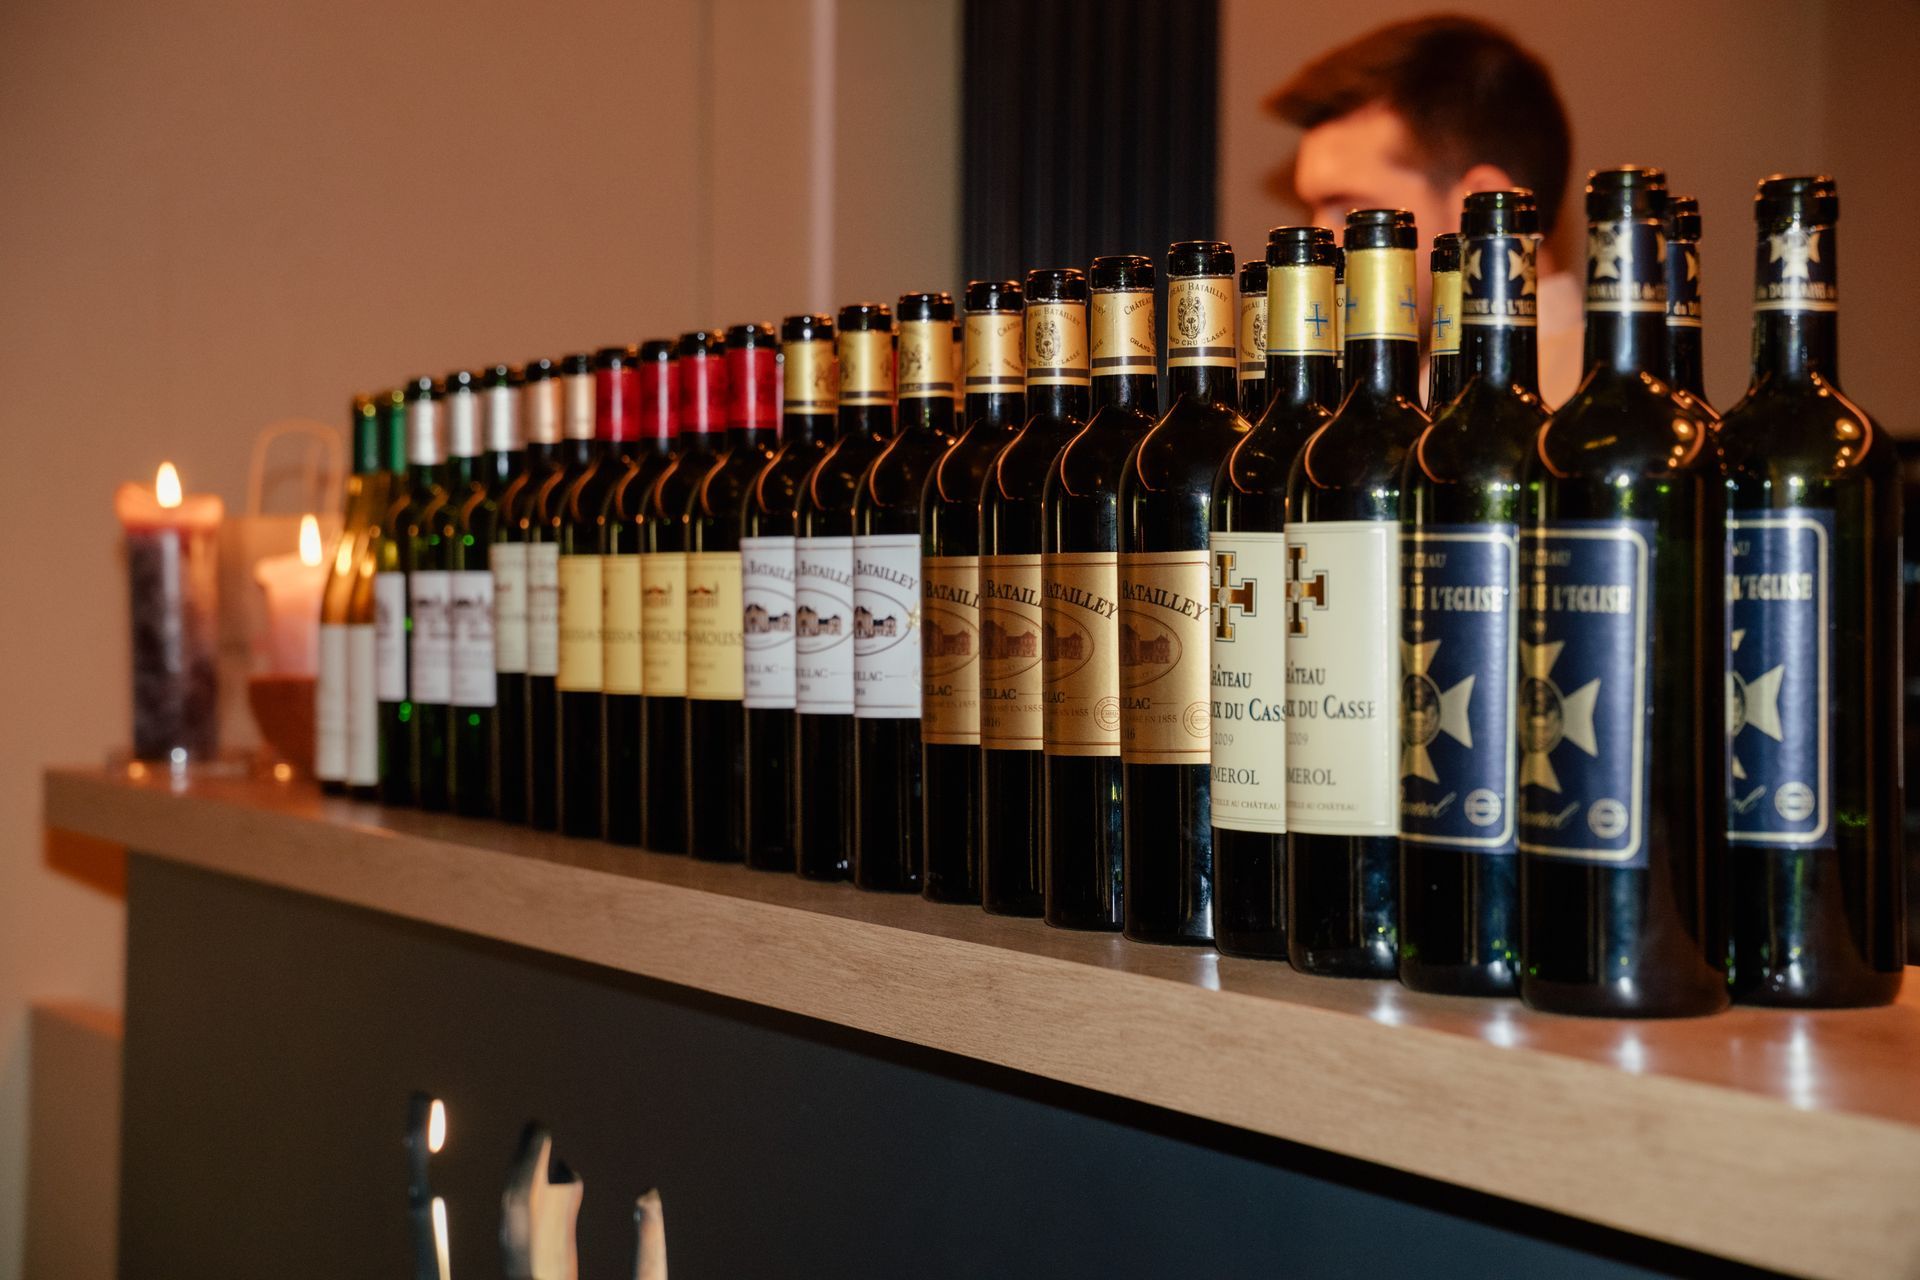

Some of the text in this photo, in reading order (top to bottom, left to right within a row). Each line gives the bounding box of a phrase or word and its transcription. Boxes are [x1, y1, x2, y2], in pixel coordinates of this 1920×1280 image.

[1188, 282, 1228, 302] BATAILLEY
[1124, 297, 1152, 315] CHÂTEA
[856, 559, 918, 591] BATAILLEY
[987, 580, 1041, 608] BATAIL
[1122, 579, 1208, 622] BATAILLEY
[1211, 664, 1253, 689] HÂTEAU
[1225, 702, 1244, 721] DU
[1299, 701, 1318, 719] DU
[1323, 694, 1376, 720] CASSE
